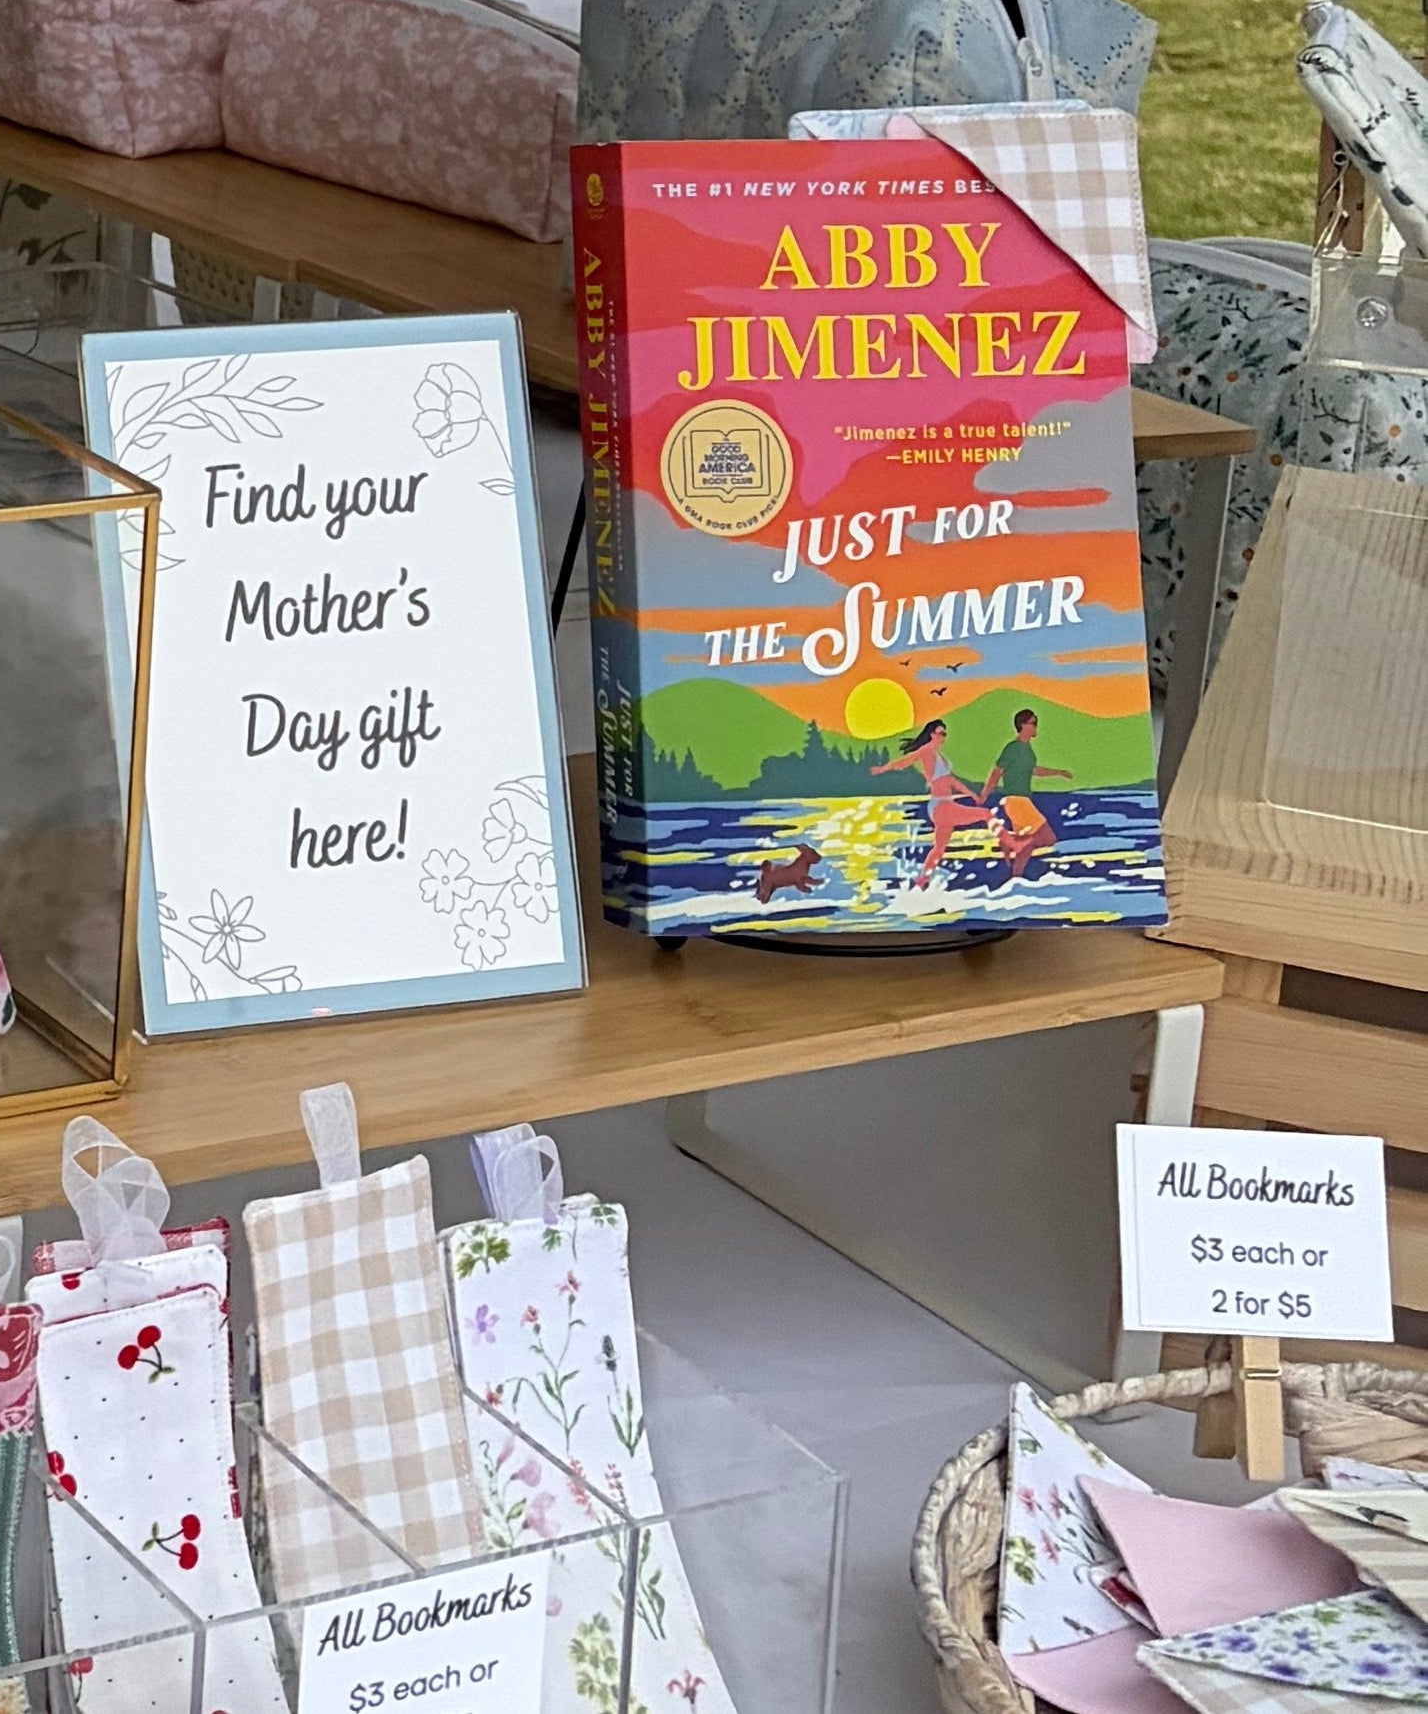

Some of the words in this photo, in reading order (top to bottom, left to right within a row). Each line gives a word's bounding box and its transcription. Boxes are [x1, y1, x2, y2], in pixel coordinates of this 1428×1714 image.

[652, 183, 698, 198] THE
[708, 182, 732, 198] #1
[744, 182, 796, 197] NEW
[807, 181, 867, 196] YORK
[877, 180, 944, 195] TIMES
[759, 222, 1002, 291] ABBY
[582, 247, 605, 378] ABBY
[677, 309, 1087, 392] JIMENEZ
[711, 445, 742, 453] GOOD
[922, 424, 937, 440] is
[943, 427, 953, 439] a
[959, 423, 996, 439] true
[961, 446, 1023, 464] HENRY
[699, 462, 756, 473] AMERICA
[702, 477, 728, 485] BOOK
[730, 477, 753, 485] CLUB
[204, 463, 316, 529] Find
[324, 470, 428, 540] your
[587, 393, 615, 616] JIMENEZ
[684, 504, 703, 523] GMA
[706, 518, 732, 530] BOOK
[736, 515, 759, 529] CLUB
[773, 504, 919, 584] JUST
[932, 497, 1014, 541] FOR
[225, 567, 431, 643] Mother's
[704, 620, 787, 668] THE
[800, 575, 1086, 677] SUMMER
[599, 645, 610, 682] THE
[241, 693, 350, 772] Day
[359, 686, 442, 769] gift
[615, 678, 632, 753] JUST
[596, 687, 618, 824] SUMMER
[622, 756, 633, 798] FOR
[289, 798, 408, 869] here!
[1158, 1161, 1202, 1199] All
[1207, 1163, 1355, 1207] Bookmarks
[1191, 1235, 1224, 1264] $3
[1232, 1242, 1295, 1266] each
[1302, 1248, 1329, 1267] or
[1211, 1289, 1227, 1315] 2
[1235, 1290, 1270, 1315] for
[1278, 1290, 1312, 1320] $5
[317, 1608, 367, 1656] All
[372, 1572, 533, 1642] Bookmarks
[349, 1681, 385, 1714] $3
[393, 1665, 461, 1701] each
[469, 1659, 499, 1682] or
